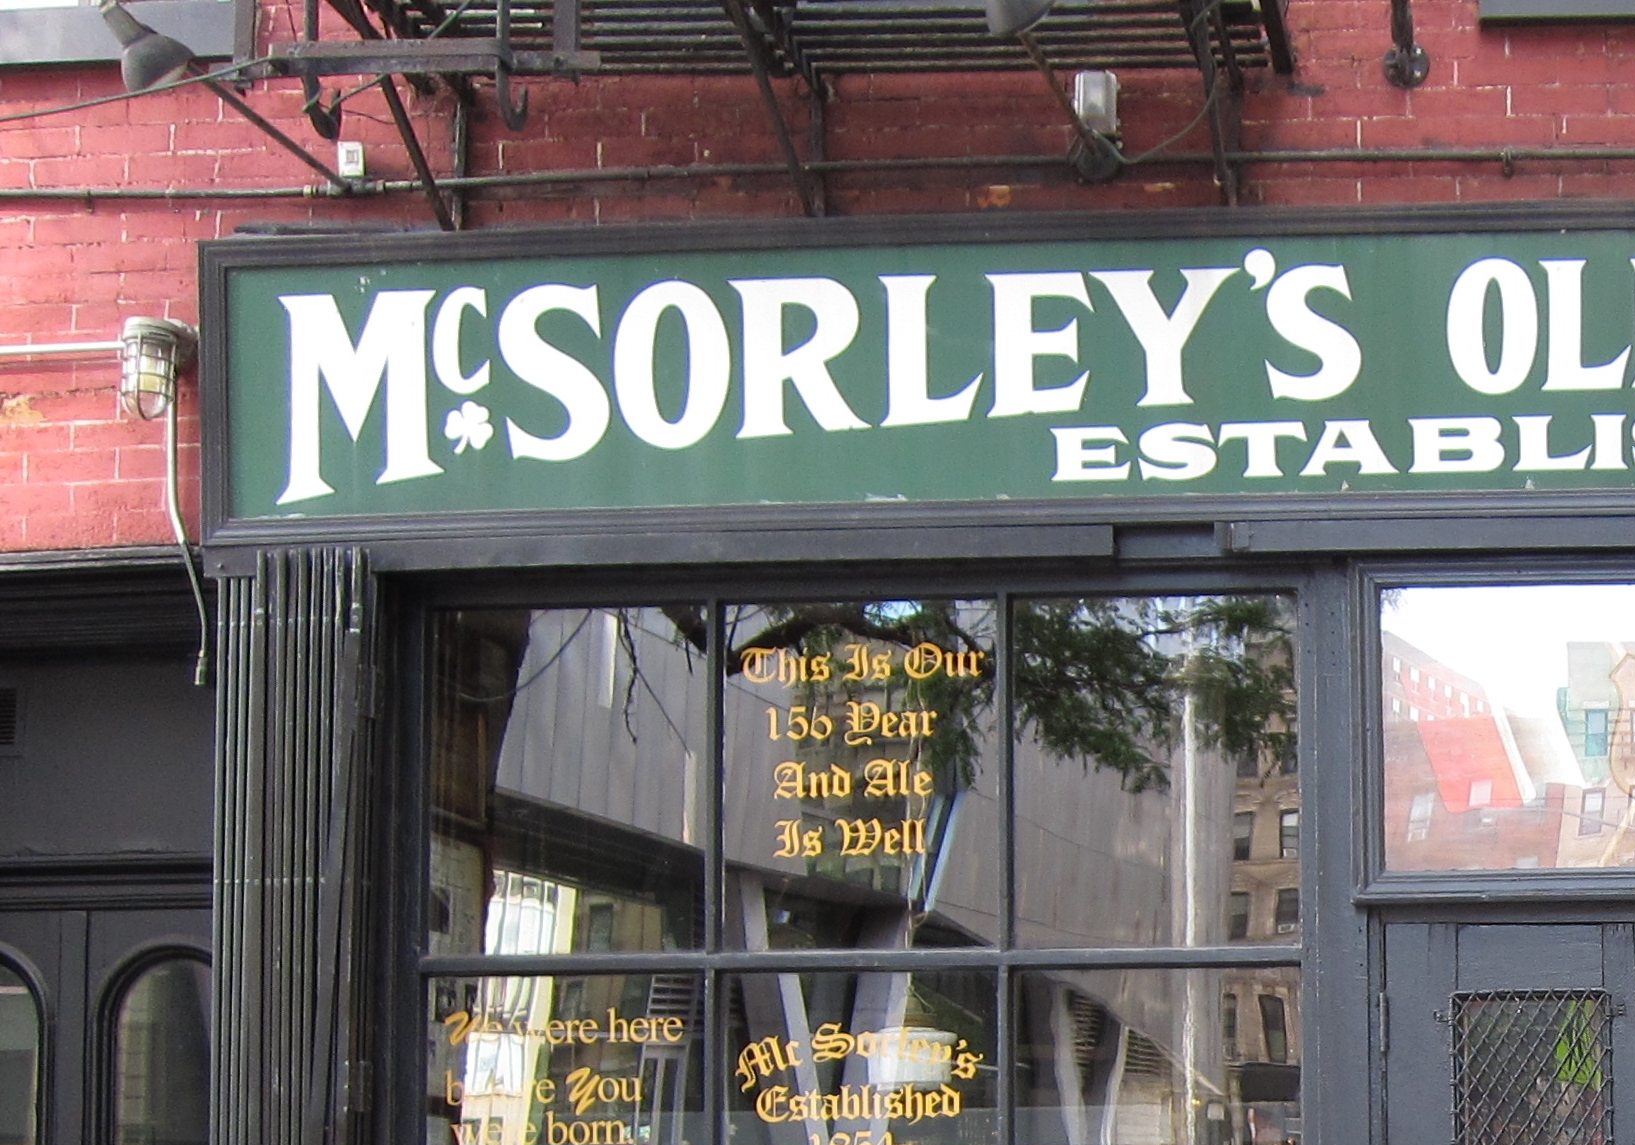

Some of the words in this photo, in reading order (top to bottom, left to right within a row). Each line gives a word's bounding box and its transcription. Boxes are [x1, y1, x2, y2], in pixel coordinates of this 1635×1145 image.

[740, 646, 831, 688] This
[843, 643, 891, 681] Is
[904, 642, 985, 679] Our
[766, 702, 833, 741] 156
[844, 701, 937, 745] Year
[774, 761, 851, 799] And
[864, 758, 933, 798] Ale
[773, 818, 823, 858] Is
[835, 817, 926, 856] Well
[607, 1007, 684, 1044] here
[735, 1034, 803, 1093] Mc
[565, 1067, 642, 1115] You
[756, 1083, 962, 1126] Established
